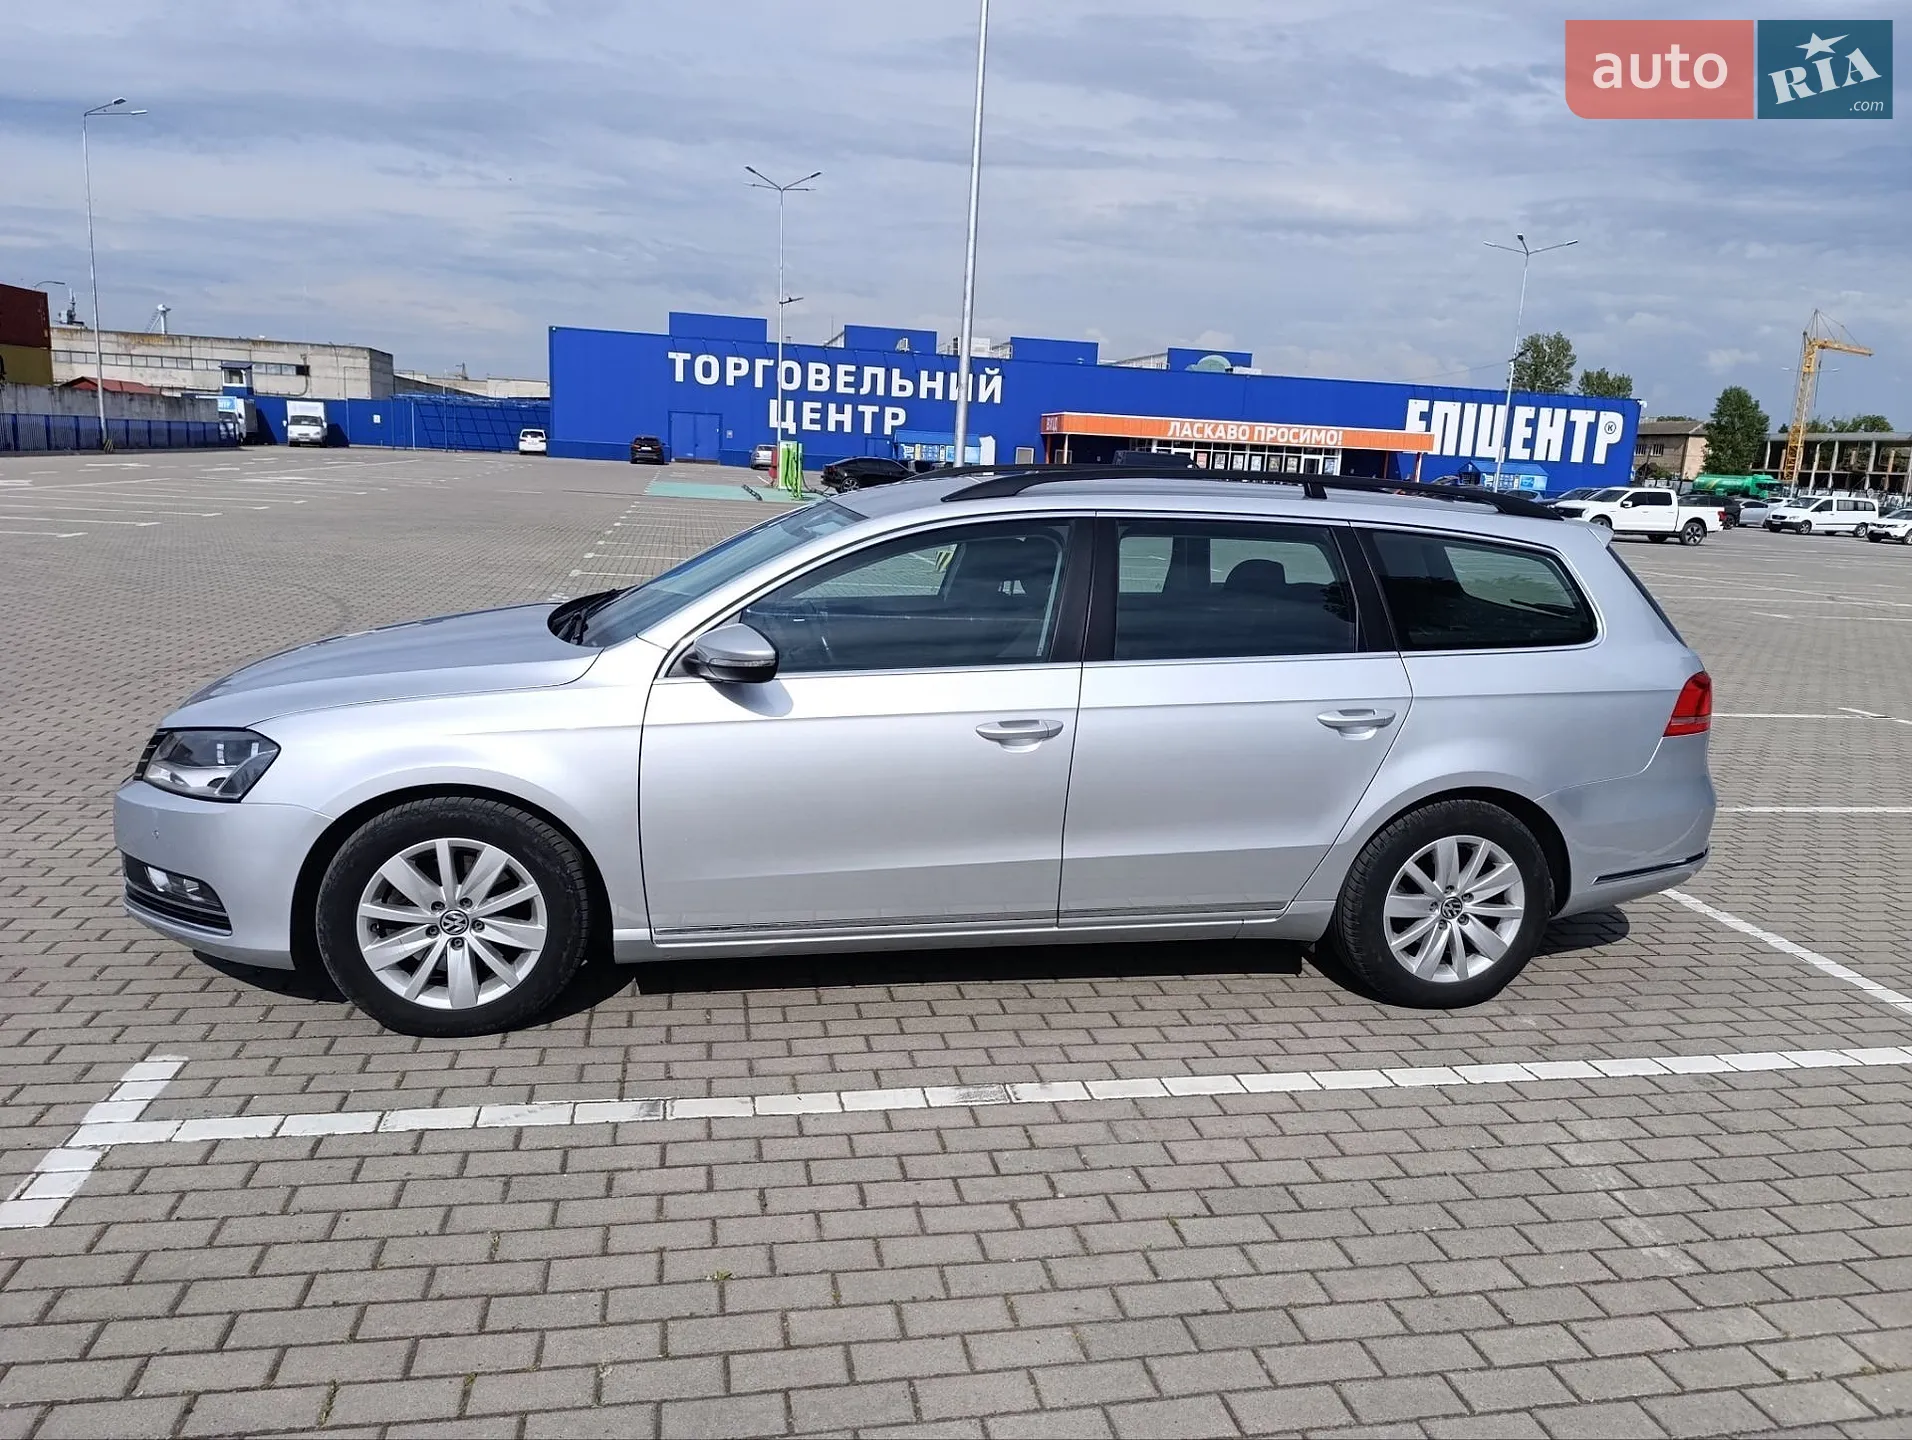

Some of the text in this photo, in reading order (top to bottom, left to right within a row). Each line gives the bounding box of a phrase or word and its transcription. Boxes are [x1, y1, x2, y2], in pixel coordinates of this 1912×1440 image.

[667, 351, 1003, 404] ТОРГОВЕЛЬНИЙ
[768, 399, 907, 435] ЦЕНТР
[1167, 421, 1344, 446] ЛАСКАВО ПРОСИМО!
[1403, 398, 1625, 464] ЕПІЦЕНТР
